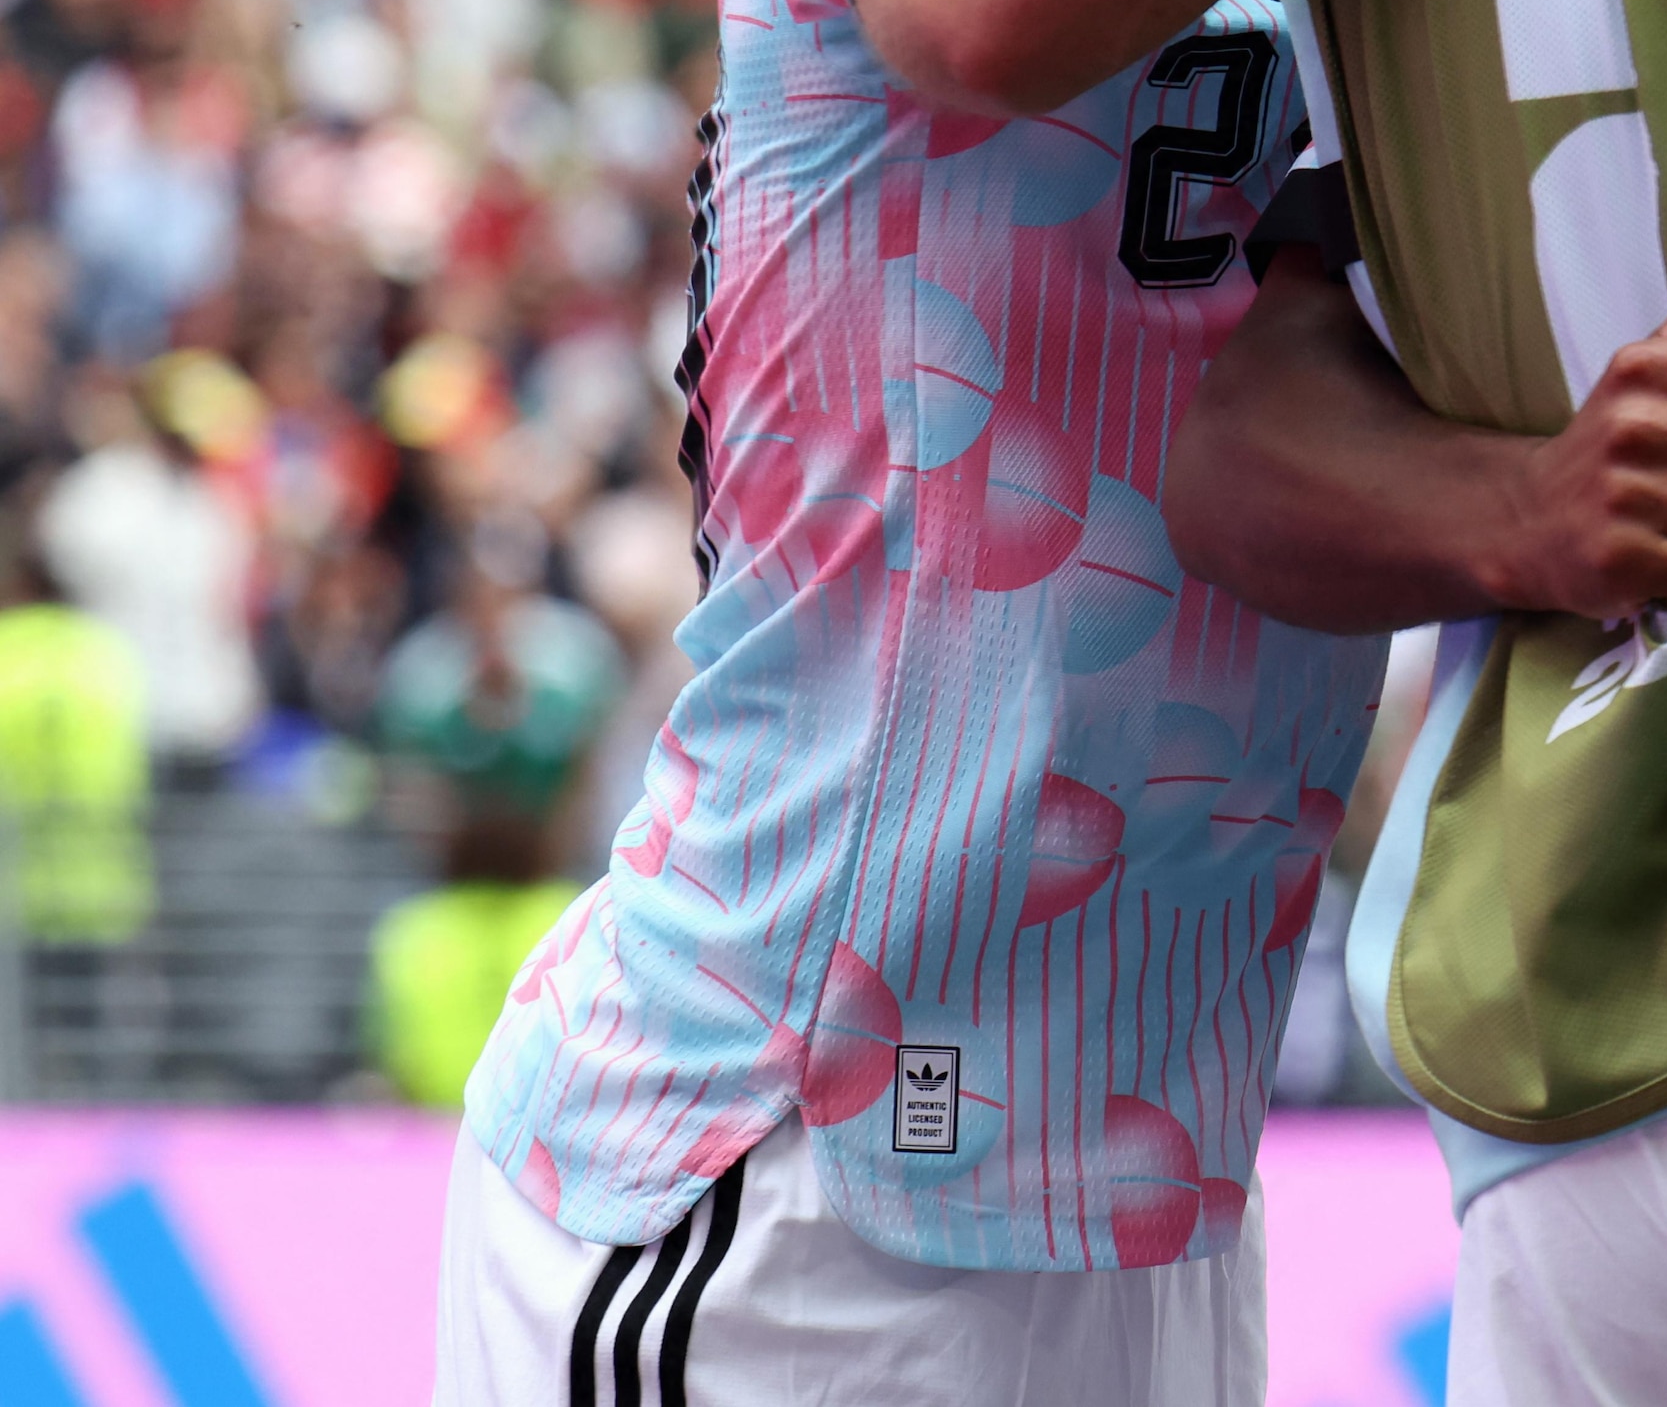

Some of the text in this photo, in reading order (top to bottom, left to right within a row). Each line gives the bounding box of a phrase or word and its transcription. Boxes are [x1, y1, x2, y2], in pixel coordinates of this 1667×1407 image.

[1118, 30, 1314, 290] 2
[907, 1101, 947, 1111] AUTHENTIC
[908, 1114, 943, 1124] LICENSED
[908, 1127, 943, 1138] PRODUCT
